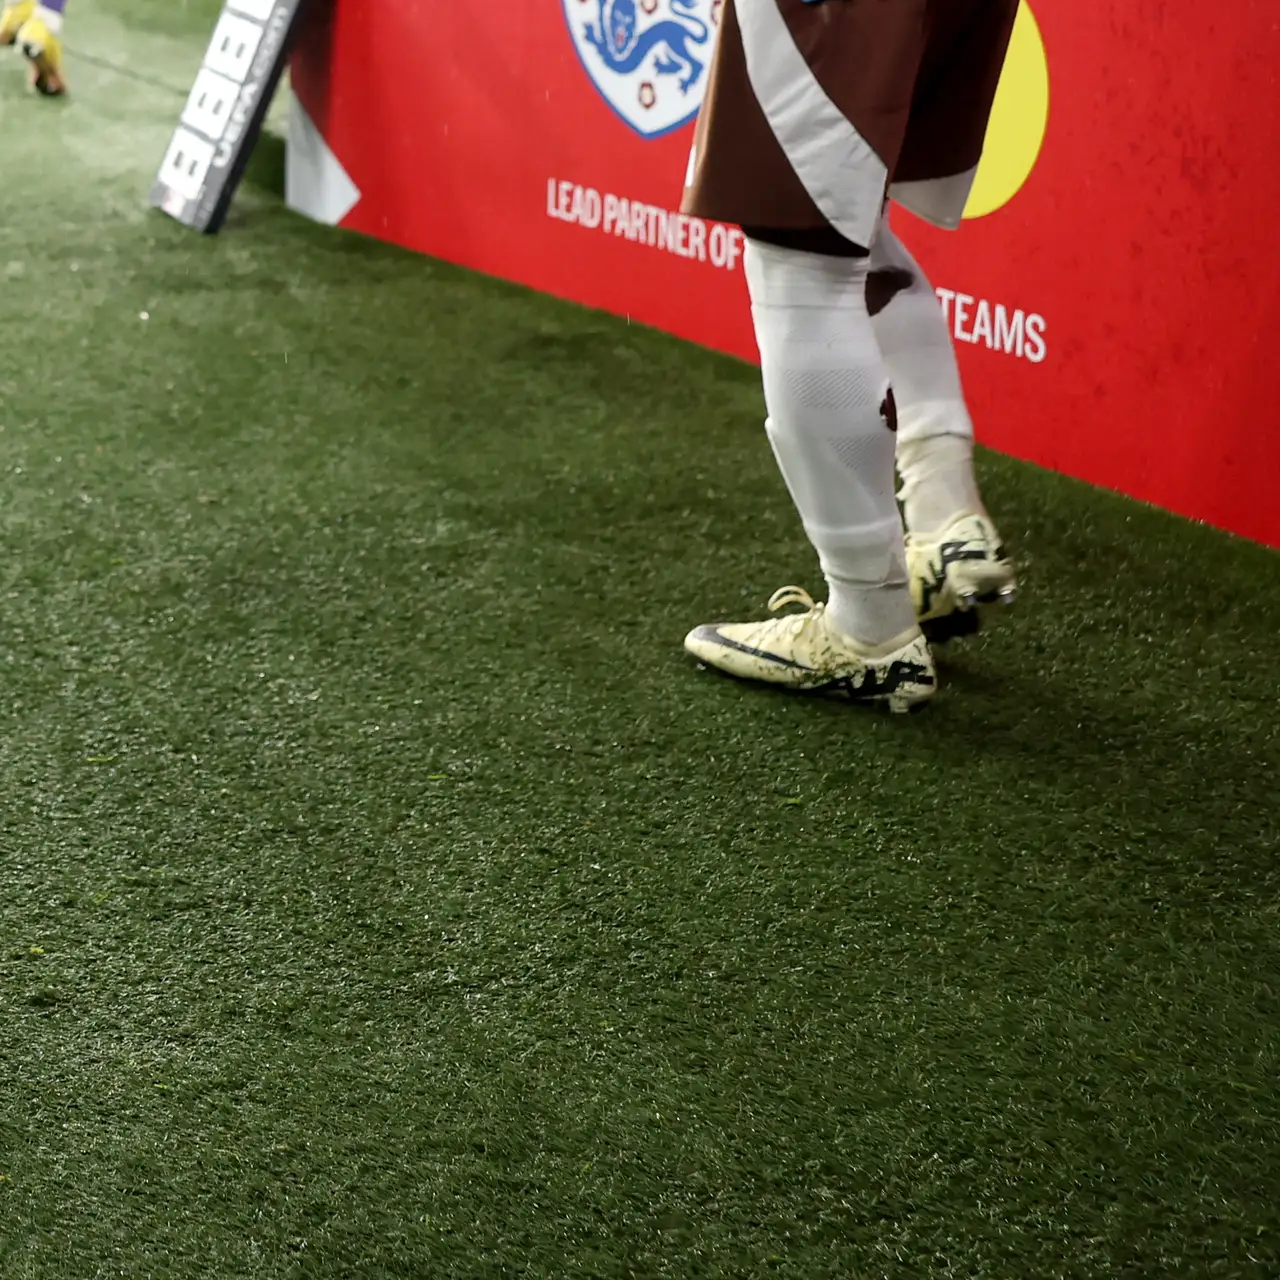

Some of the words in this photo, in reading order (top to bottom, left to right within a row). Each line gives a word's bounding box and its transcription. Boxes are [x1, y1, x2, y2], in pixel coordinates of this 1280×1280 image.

[212, 6, 290, 168] UEFA.com
[546, 177, 602, 229] LEAD
[602, 192, 707, 262] PARTNER
[708, 223, 743, 271] OF
[934, 286, 1047, 363] TEAMS
